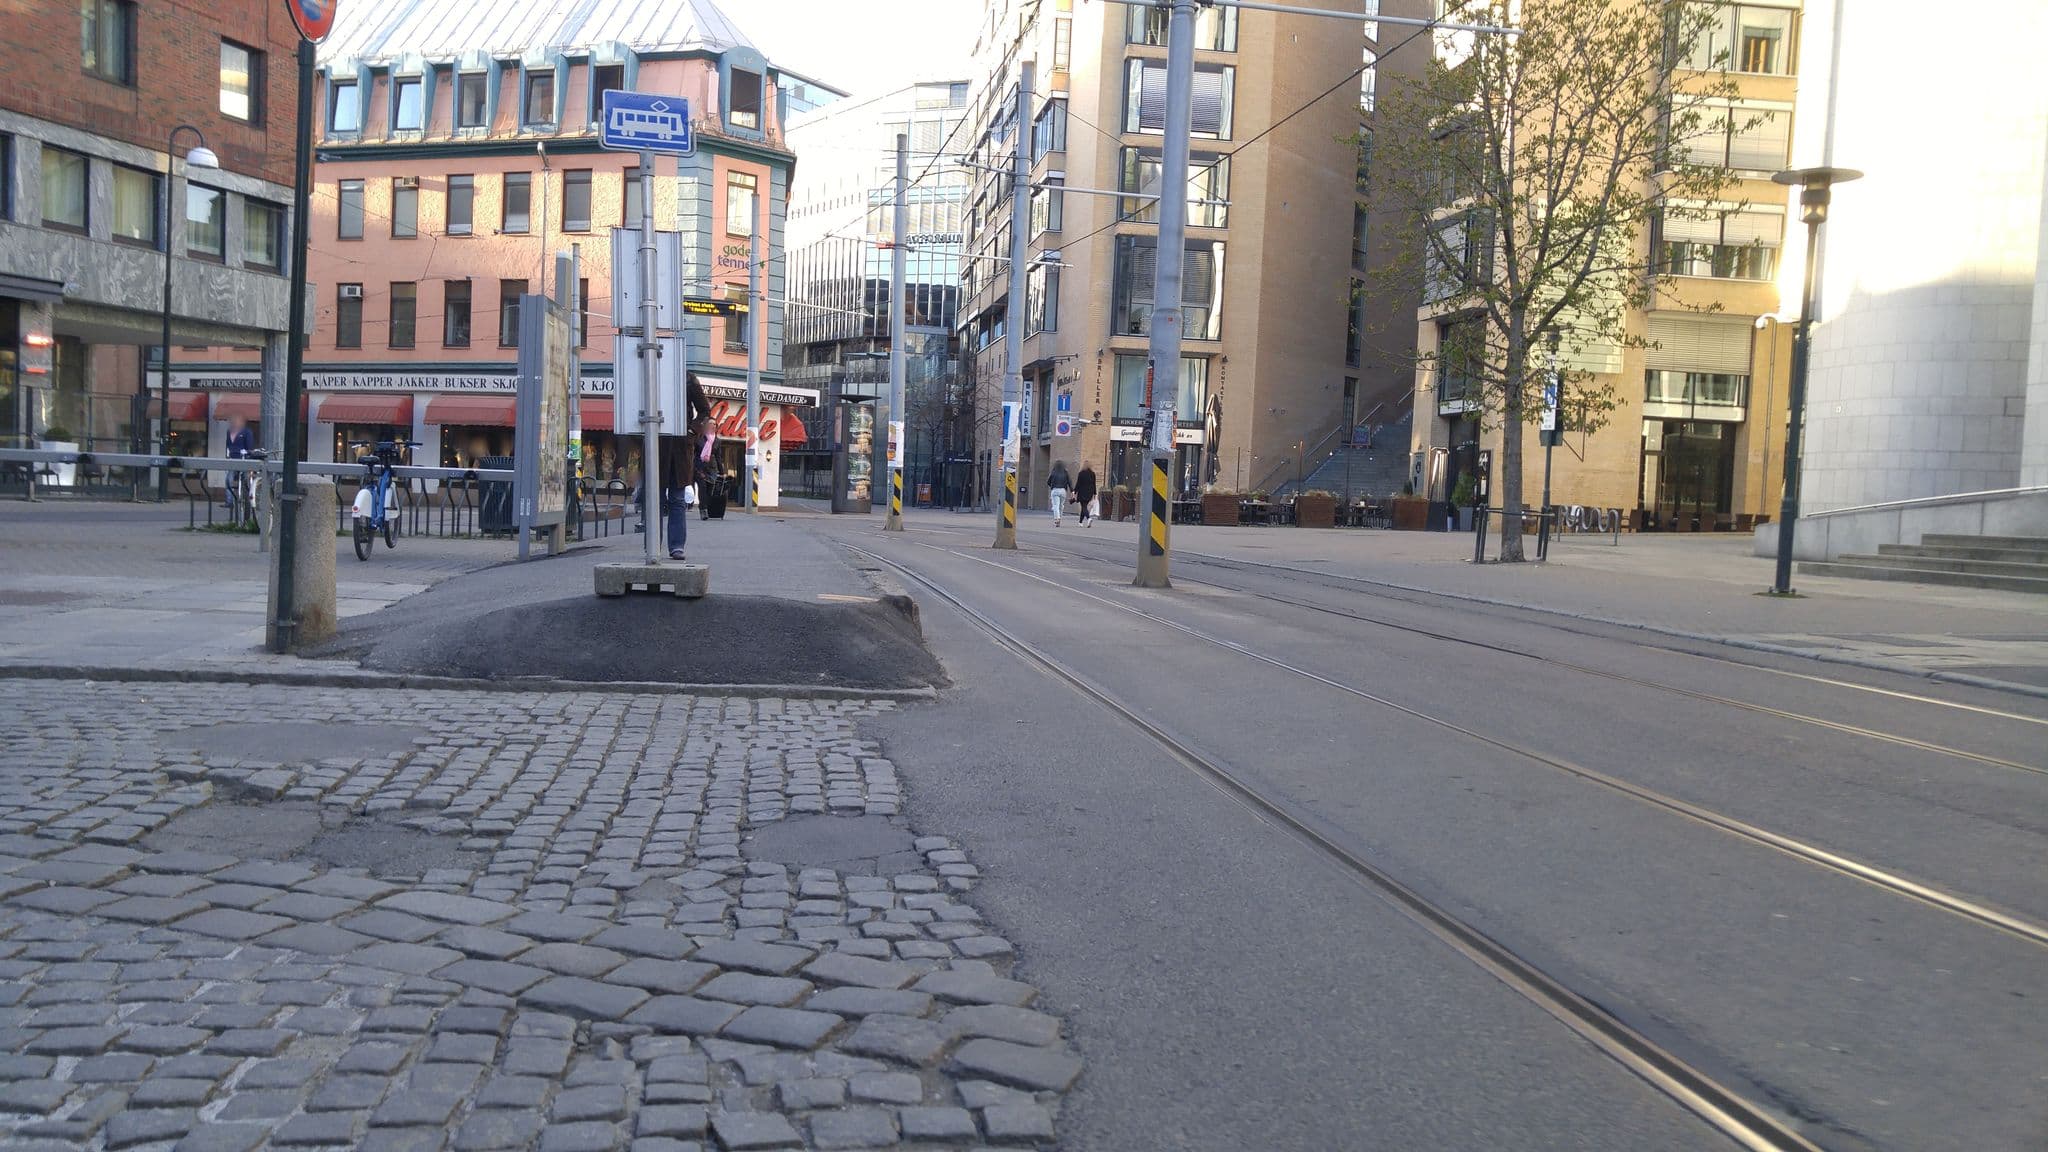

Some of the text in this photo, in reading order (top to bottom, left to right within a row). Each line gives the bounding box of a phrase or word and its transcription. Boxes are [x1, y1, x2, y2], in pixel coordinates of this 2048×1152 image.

[723, 244, 751, 257] gode
[717, 255, 750, 270] tenne
[353, 376, 393, 387] KAPPER
[397, 376, 439, 388] JAKKER
[445, 377, 487, 389] BUKSER
[1094, 358, 1103, 404] BRILLER
[710, 386, 743, 398] VOKSNE
[742, 390, 748, 399] O
[759, 392, 776, 402] NGE
[1023, 383, 1031, 435] BRILLER
